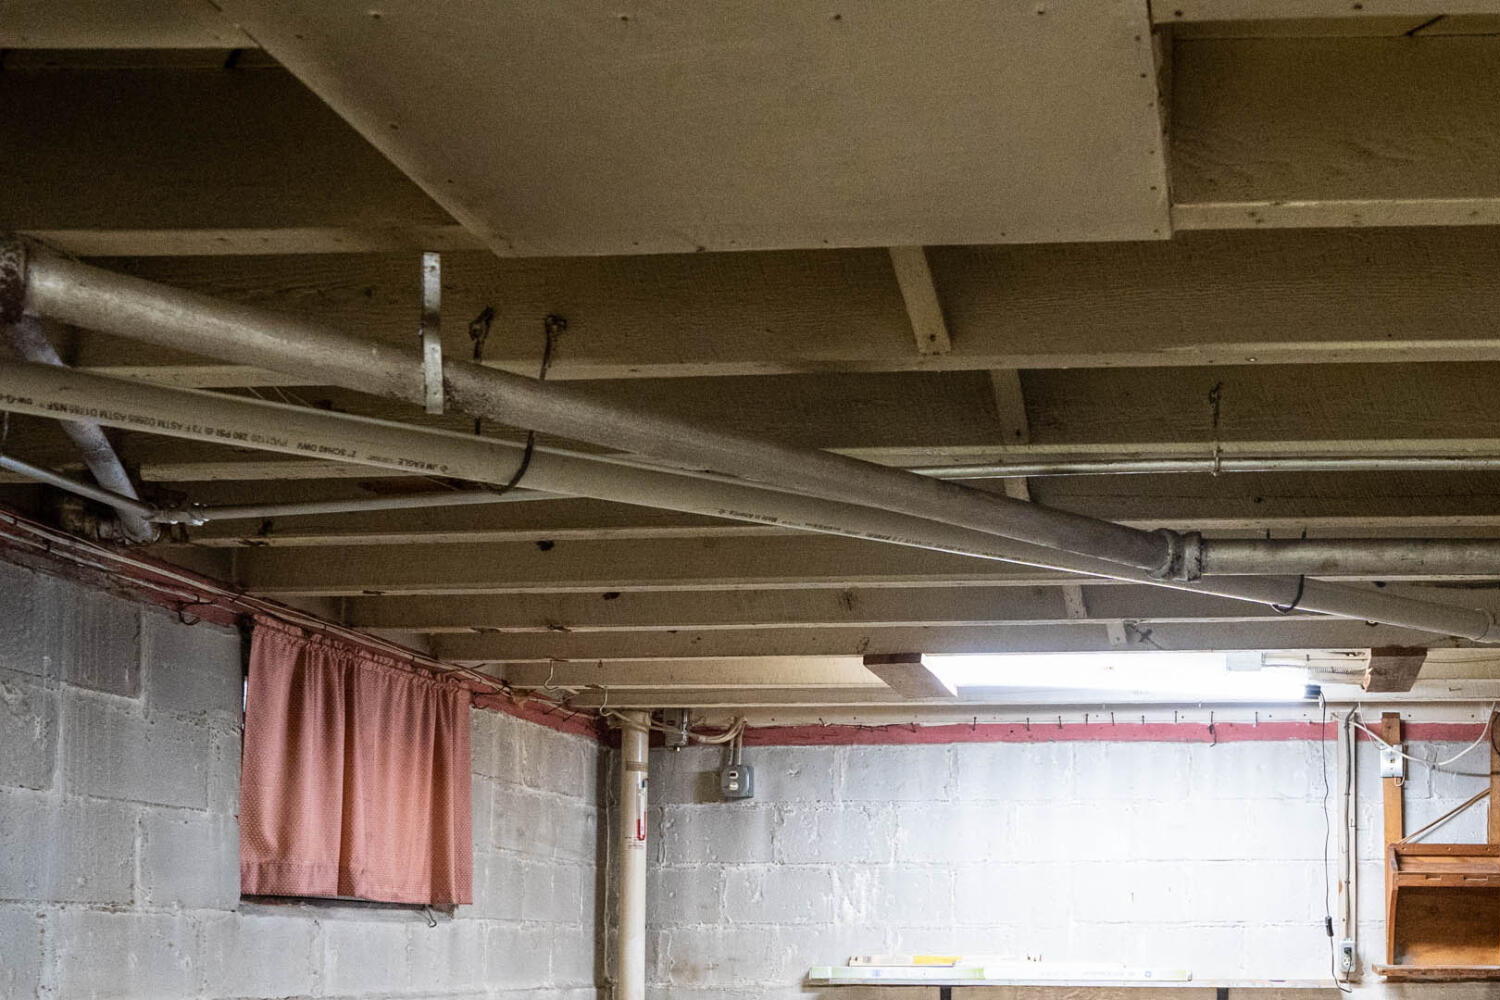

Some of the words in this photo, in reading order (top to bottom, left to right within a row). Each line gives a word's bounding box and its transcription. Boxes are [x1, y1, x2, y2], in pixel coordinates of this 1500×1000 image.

[47, 401, 68, 412] NSF
[99, 409, 126, 422] ASTM
[157, 419, 183, 431] ASTM
[216, 429, 232, 438] PSI
[398, 458, 425, 469] EAGLE
